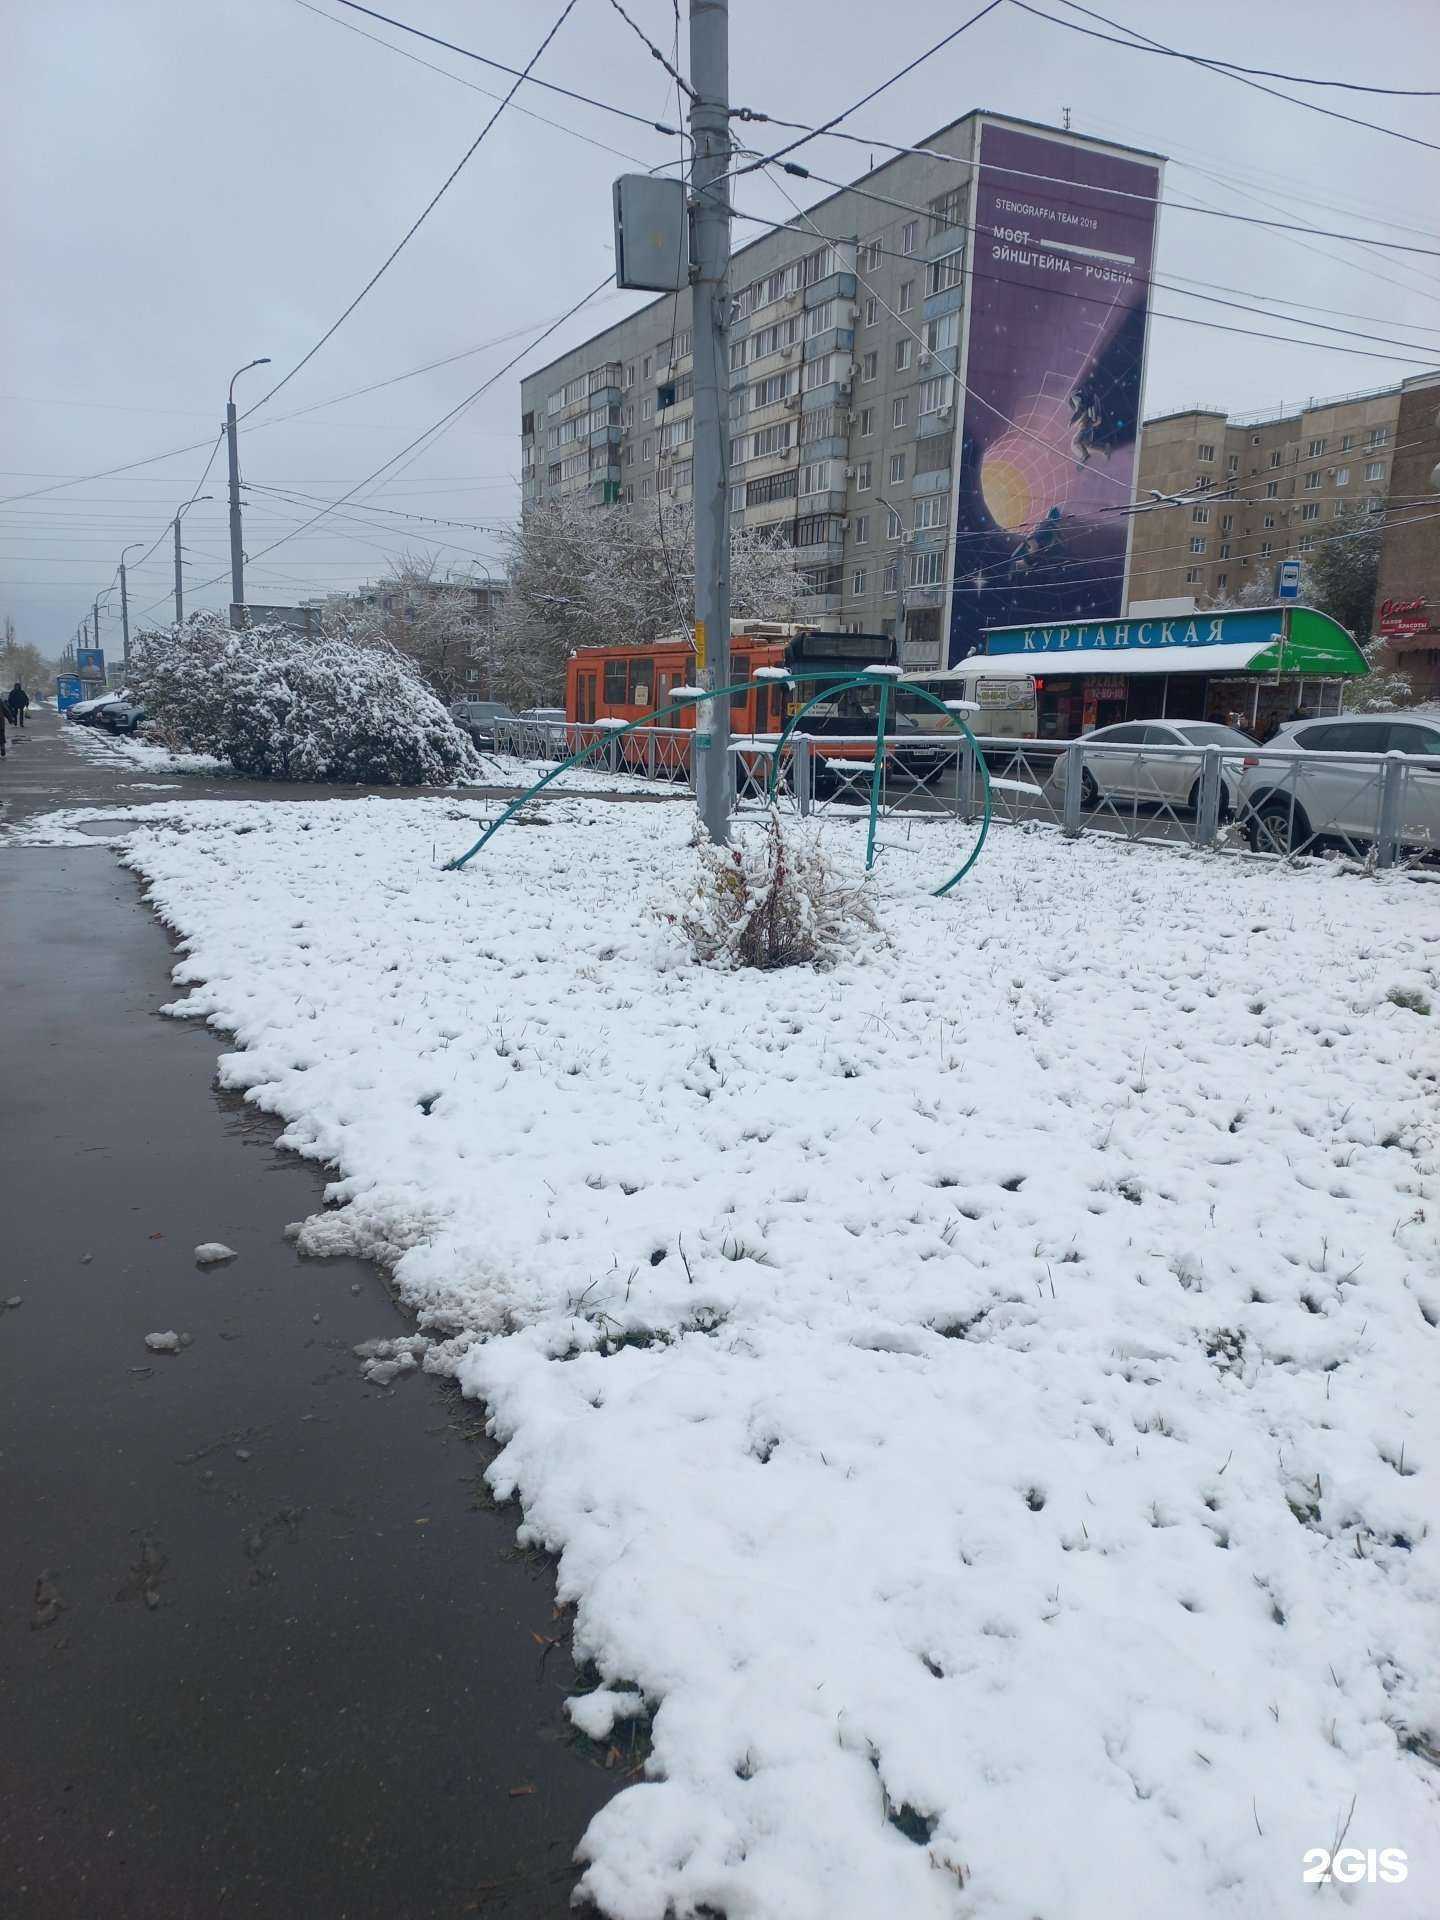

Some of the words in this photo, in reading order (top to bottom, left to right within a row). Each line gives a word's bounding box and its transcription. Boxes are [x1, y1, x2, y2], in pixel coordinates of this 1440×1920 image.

[995, 198, 1056, 220] STENOGRAFFIA
[1057, 211, 1079, 225] TEAM
[993, 226, 1030, 245] МОСТ
[991, 245, 1071, 273] ЭЙНШТЕЙНА
[1086, 265, 1134, 285] РОЗЕНА
[1023, 618, 1225, 650] КУРГАНСКАЯ
[1397, 622, 1428, 630] КРАСОТЫ
